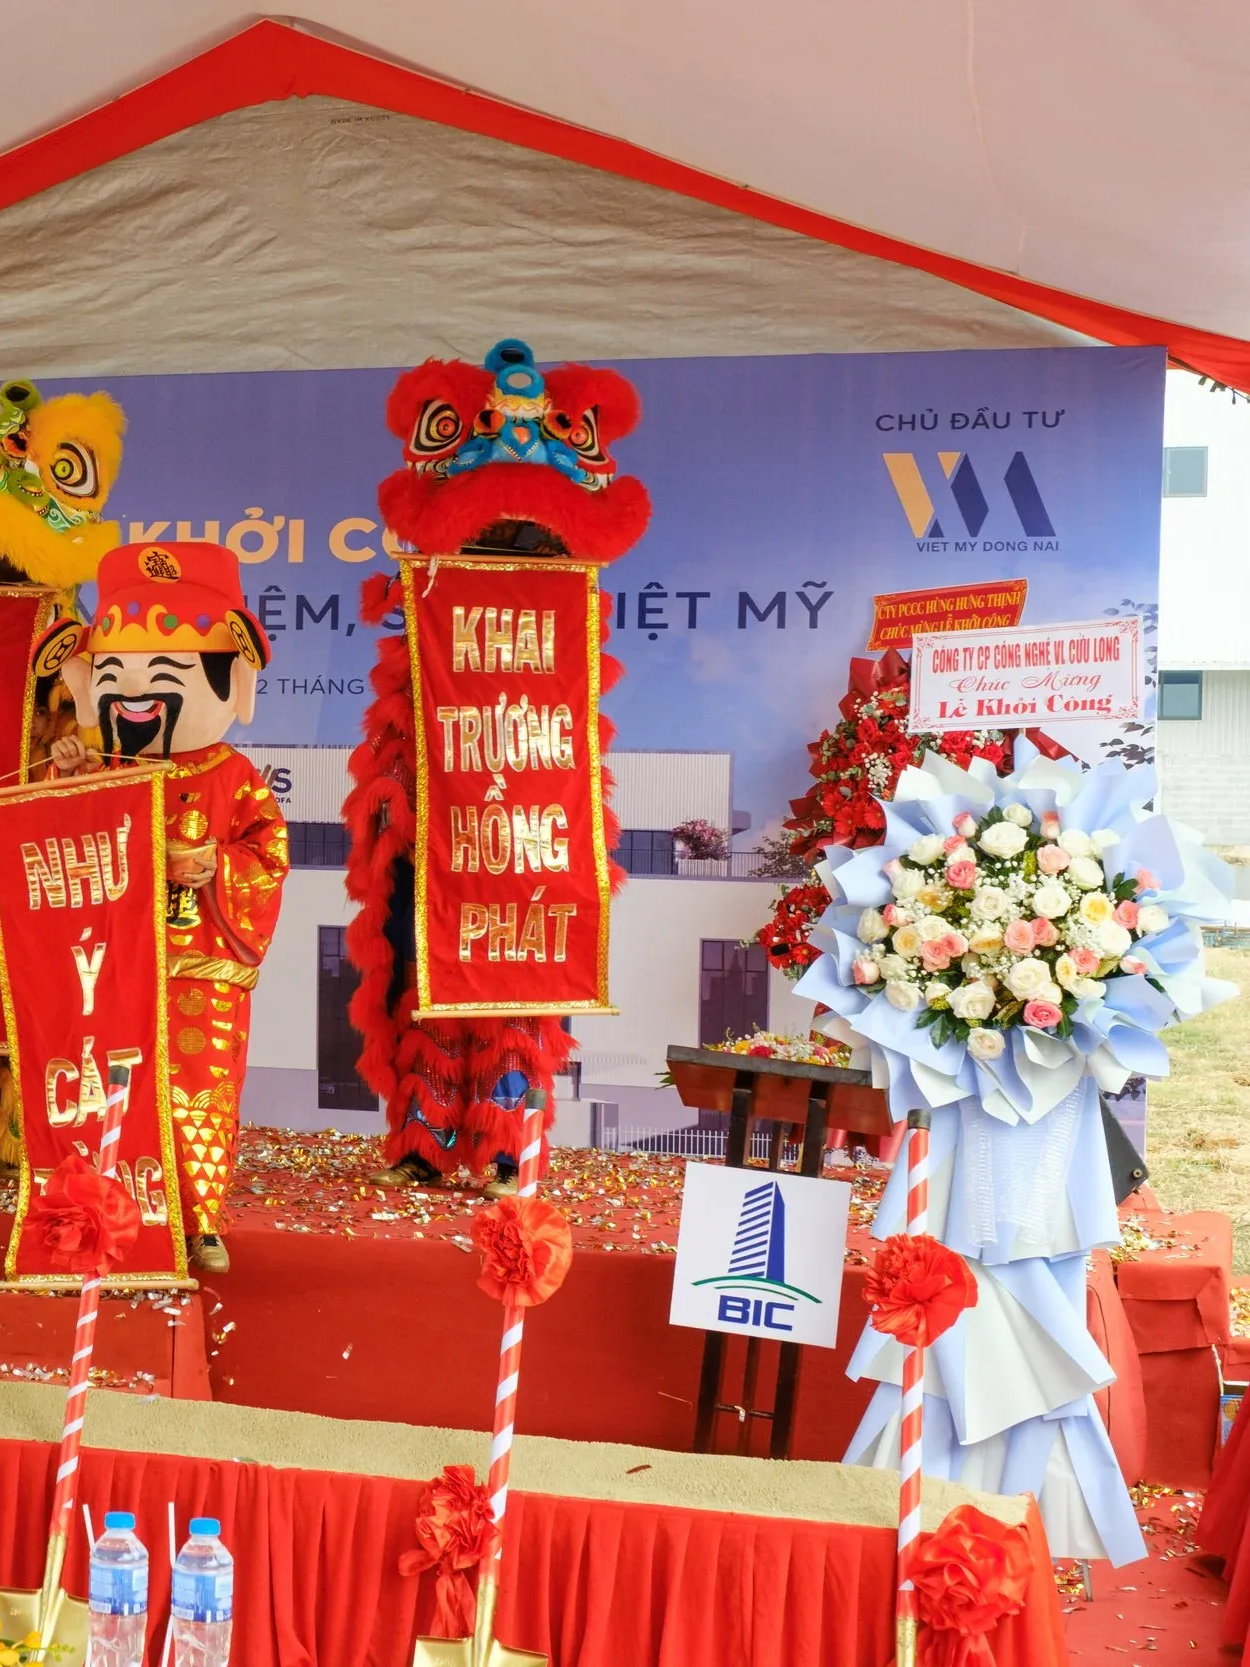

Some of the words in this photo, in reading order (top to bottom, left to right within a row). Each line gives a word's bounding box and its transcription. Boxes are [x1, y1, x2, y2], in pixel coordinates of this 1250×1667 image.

[876, 408, 938, 431] CHỦ
[950, 407, 1011, 430] ĐẦU
[1022, 410, 1065, 428] TƯ
[917, 542, 950, 552] VIET
[955, 541, 977, 552] MY
[983, 541, 1028, 552] DONG
[1033, 541, 1059, 551] NAI
[616, 582, 711, 641] IỆT
[738, 581, 834, 629] MỸ
[878, 604, 899, 620] CTY
[899, 602, 925, 617] PCCC
[926, 597, 954, 614] HÙNG
[955, 594, 986, 611] HƯNG
[987, 592, 1021, 609] THỊNH
[452, 606, 556, 673] KHAI
[880, 623, 909, 640] CHÚC
[940, 614, 953, 632] LỄ
[982, 613, 1011, 628] CÔNG
[932, 646, 959, 673] CÔNG
[963, 647, 975, 672] TY
[977, 646, 991, 670] CP
[1054, 640, 1065, 665] VL
[1068, 633, 1090, 664] CỬU
[1093, 636, 1120, 662] LONG
[278, 675, 364, 695] THÁNG
[949, 675, 1010, 693] Chúc
[1021, 671, 1101, 692] Mừng
[976, 696, 1037, 717] Khởi
[1046, 694, 1113, 715] Công
[437, 691, 576, 774] TRƯƠNG
[451, 774, 570, 874] HỒNG
[21, 813, 132, 911] NHƯ
[458, 885, 577, 963] PHÁT
[71, 927, 106, 1016] Ý
[45, 1035, 143, 1128] CÁT
[718, 1295, 795, 1331] BIC
